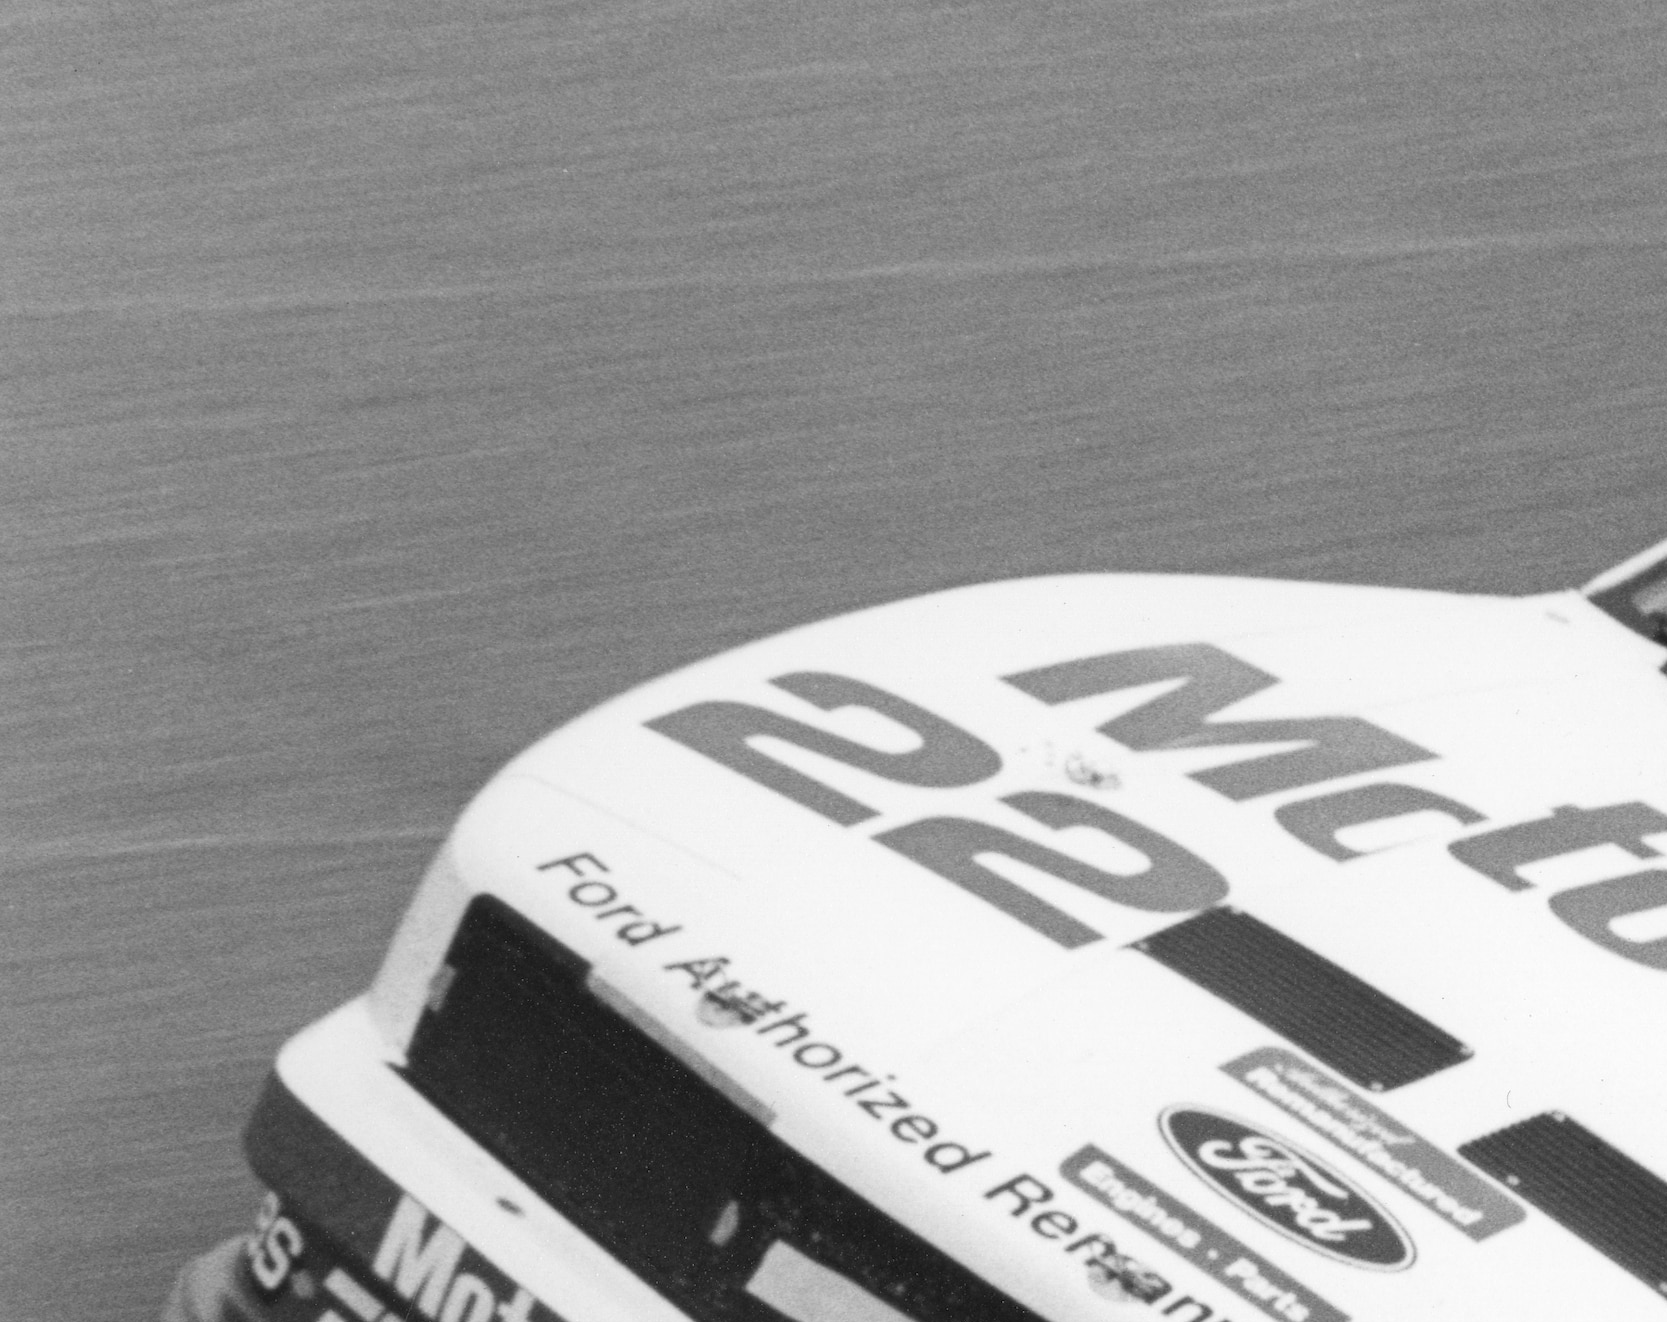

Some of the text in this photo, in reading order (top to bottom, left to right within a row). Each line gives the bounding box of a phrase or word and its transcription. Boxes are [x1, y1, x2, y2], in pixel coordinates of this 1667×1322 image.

[641, 671, 1230, 950] 22
[535, 852, 682, 946] Ford
[663, 956, 991, 1174] Authorized
[1080, 1161, 1202, 1249] Engines
[1199, 1136, 1373, 1242] Ford
